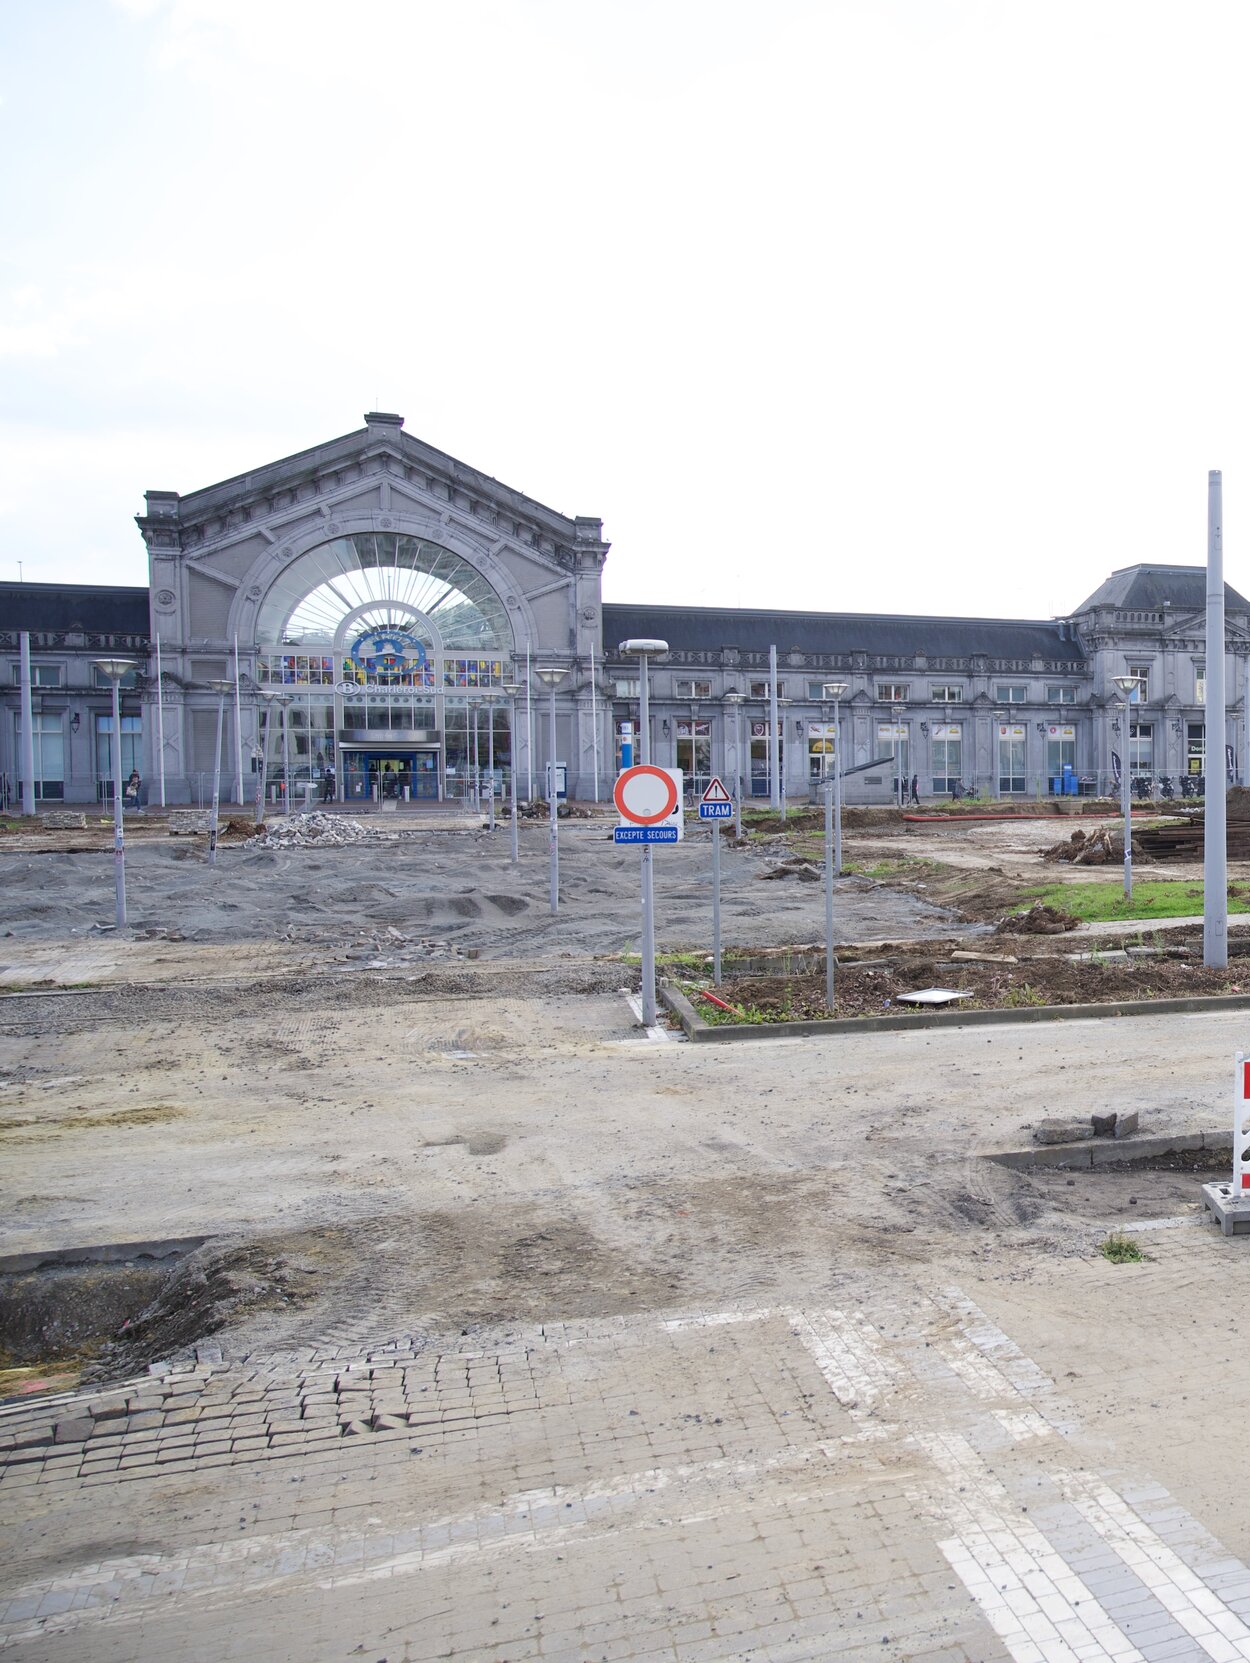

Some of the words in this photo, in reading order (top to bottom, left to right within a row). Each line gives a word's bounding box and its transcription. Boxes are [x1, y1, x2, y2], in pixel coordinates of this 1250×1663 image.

[365, 683, 444, 694] Charleroi-Sud
[703, 805, 730, 816] TRAM
[615, 830, 645, 840] EXCEPTE
[647, 830, 677, 840] SECOURS
